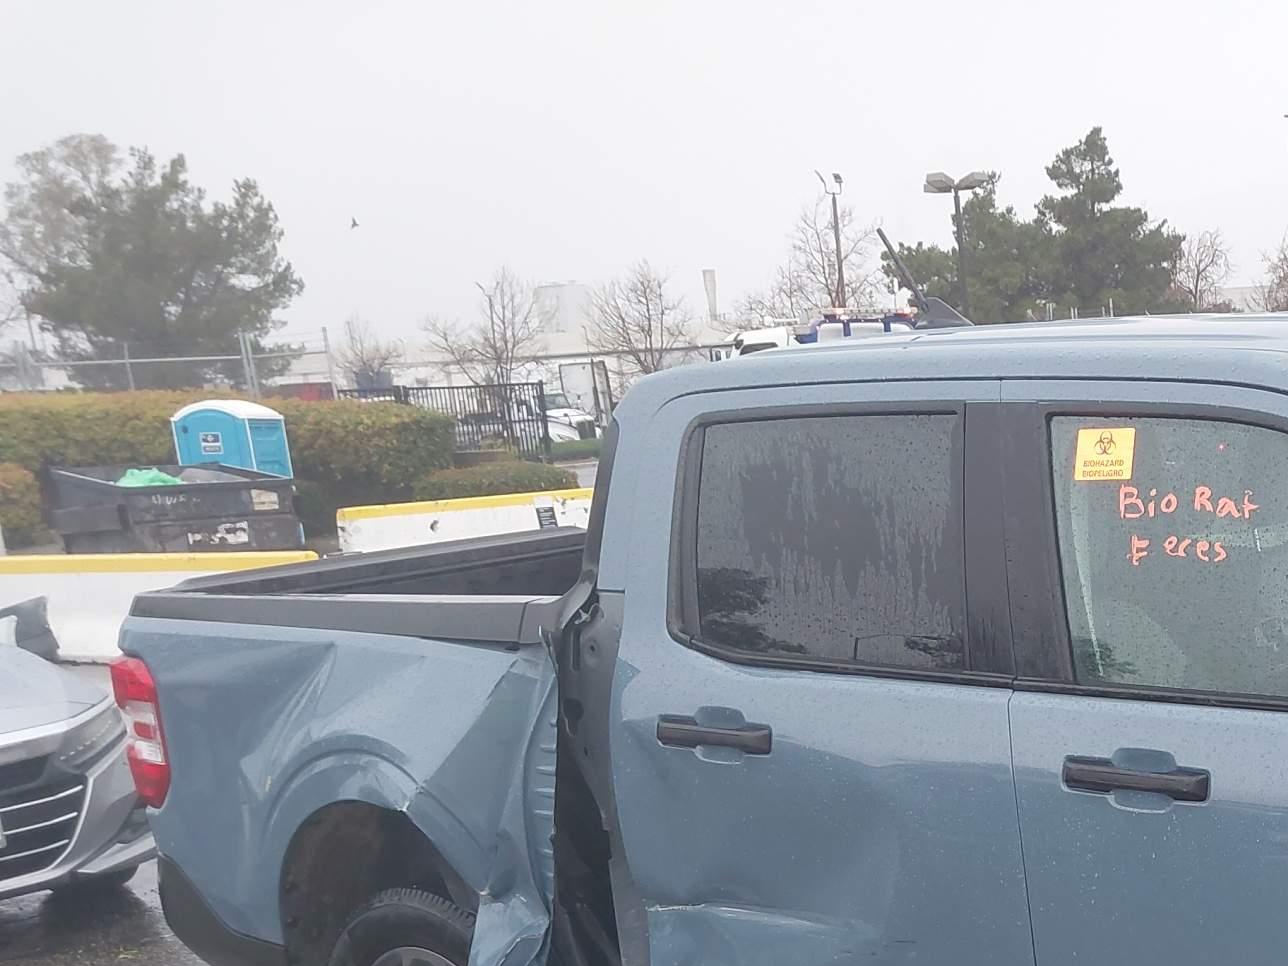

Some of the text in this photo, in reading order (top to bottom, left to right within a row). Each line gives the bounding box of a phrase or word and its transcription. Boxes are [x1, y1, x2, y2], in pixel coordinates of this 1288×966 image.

[1083, 459, 1125, 468] BIOHAZARD
[1082, 469, 1124, 478] BIOPELIGRO
[1119, 485, 1178, 519] Bio
